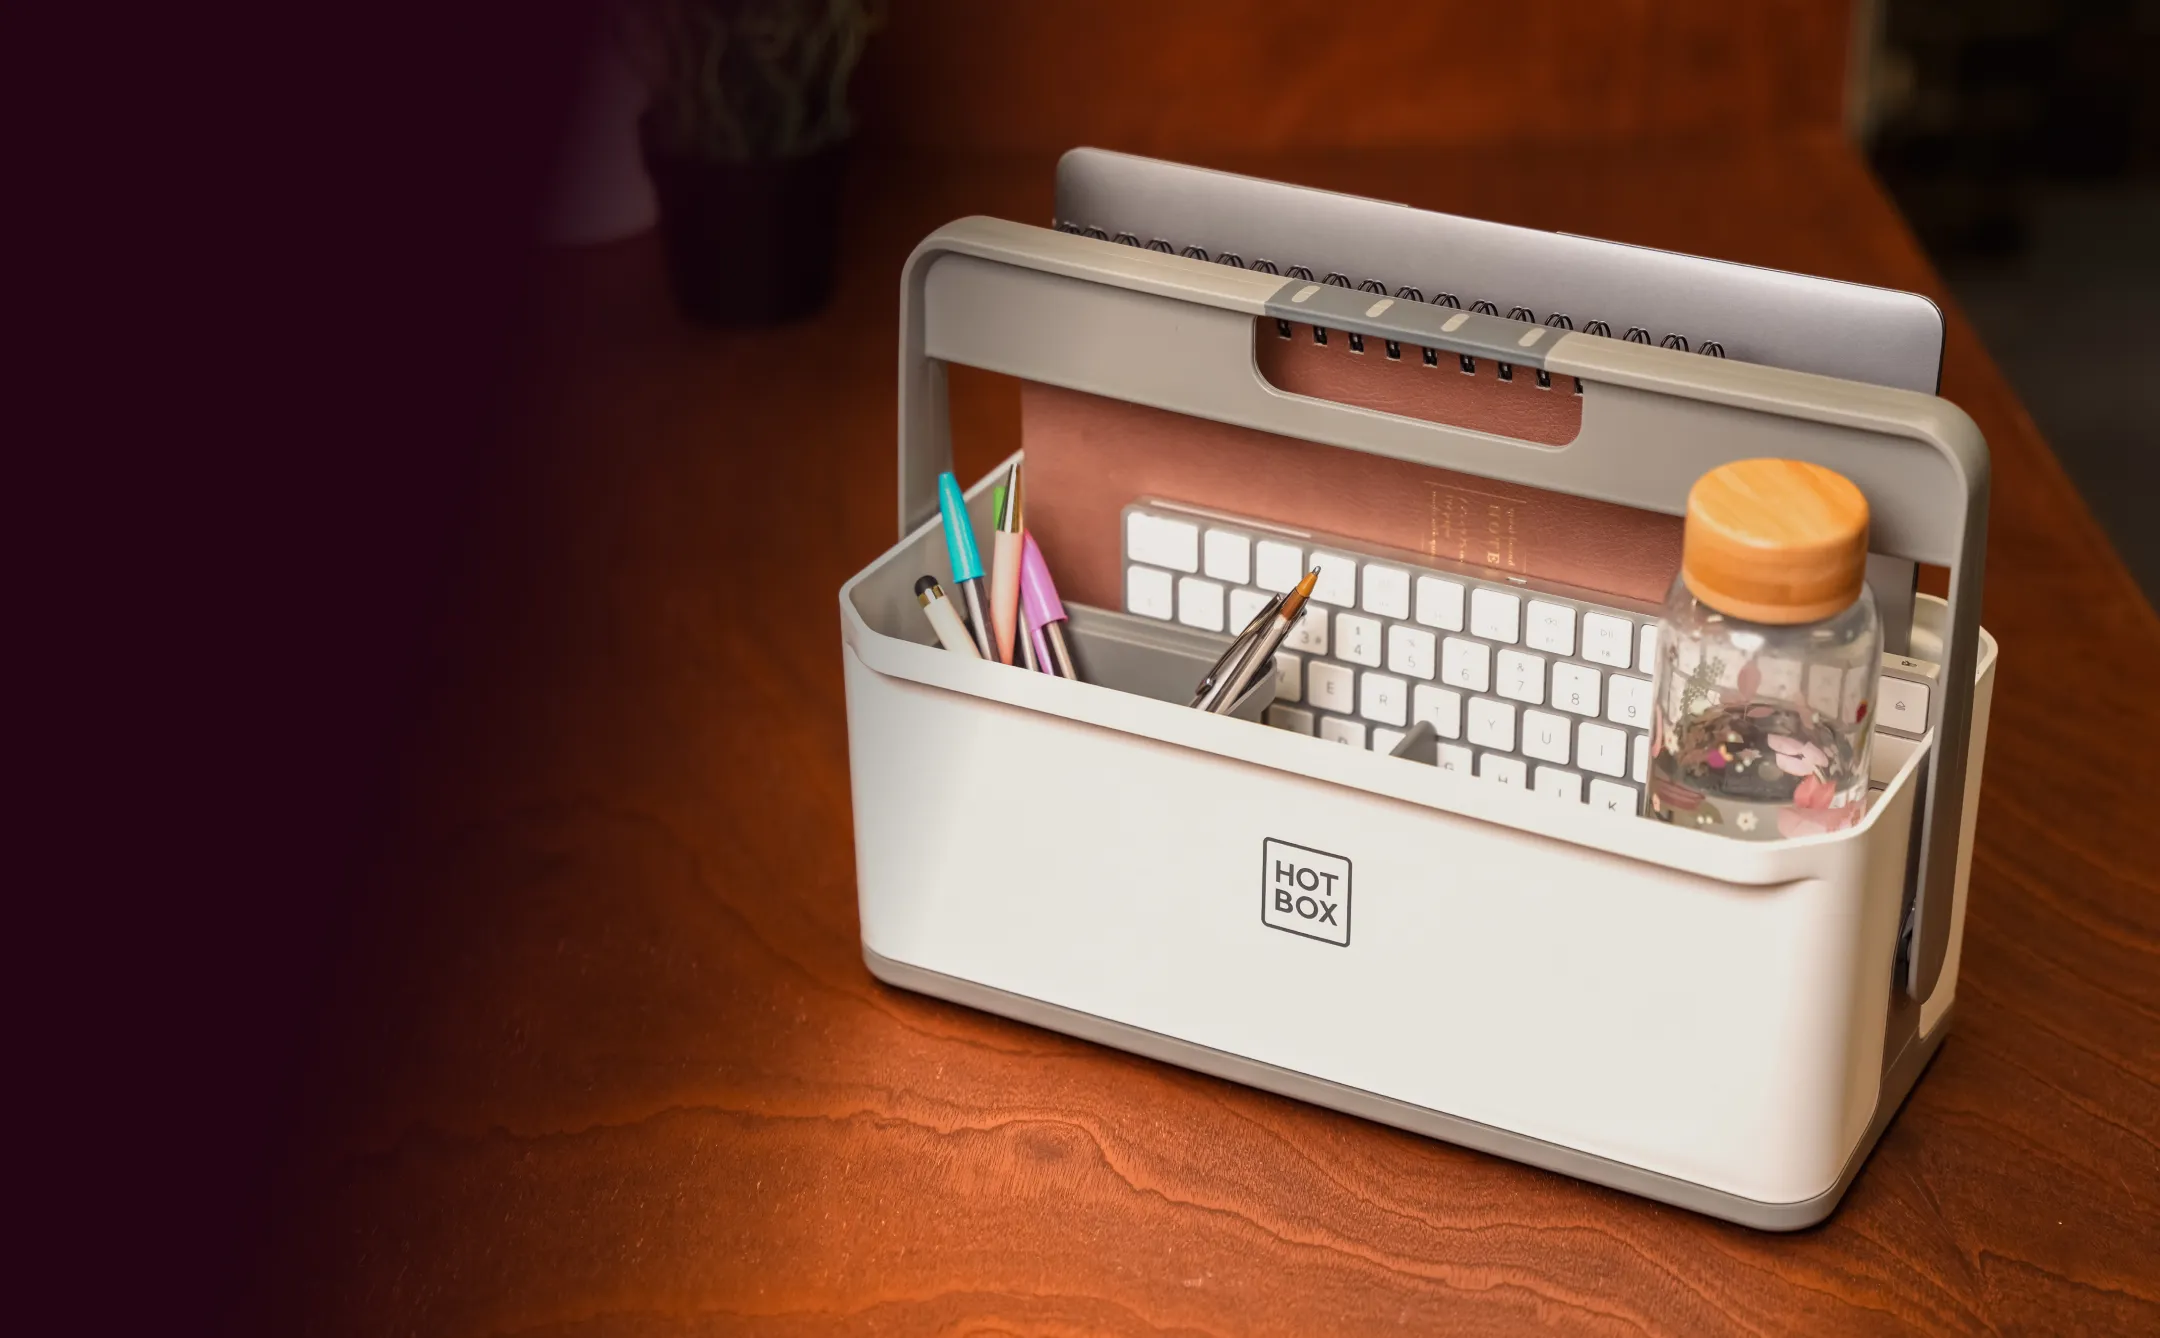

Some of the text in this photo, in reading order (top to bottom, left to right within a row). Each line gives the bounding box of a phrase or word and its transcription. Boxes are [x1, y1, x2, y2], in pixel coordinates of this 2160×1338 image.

[1301, 630, 1310, 644] 3
[1353, 644, 1362, 656] 4
[1407, 656, 1416, 669] 5
[1461, 668, 1470, 681] 6
[1326, 681, 1335, 695] E
[1516, 680, 1524, 692] 7
[1379, 694, 1388, 706] R
[1571, 693, 1580, 706] 8
[1433, 706, 1440, 717] T
[1627, 705, 1637, 718] 9
[1487, 718, 1496, 730] Y
[1541, 731, 1552, 744] U
[1275, 860, 1339, 896] HOT
[1275, 888, 1338, 927] BOX
